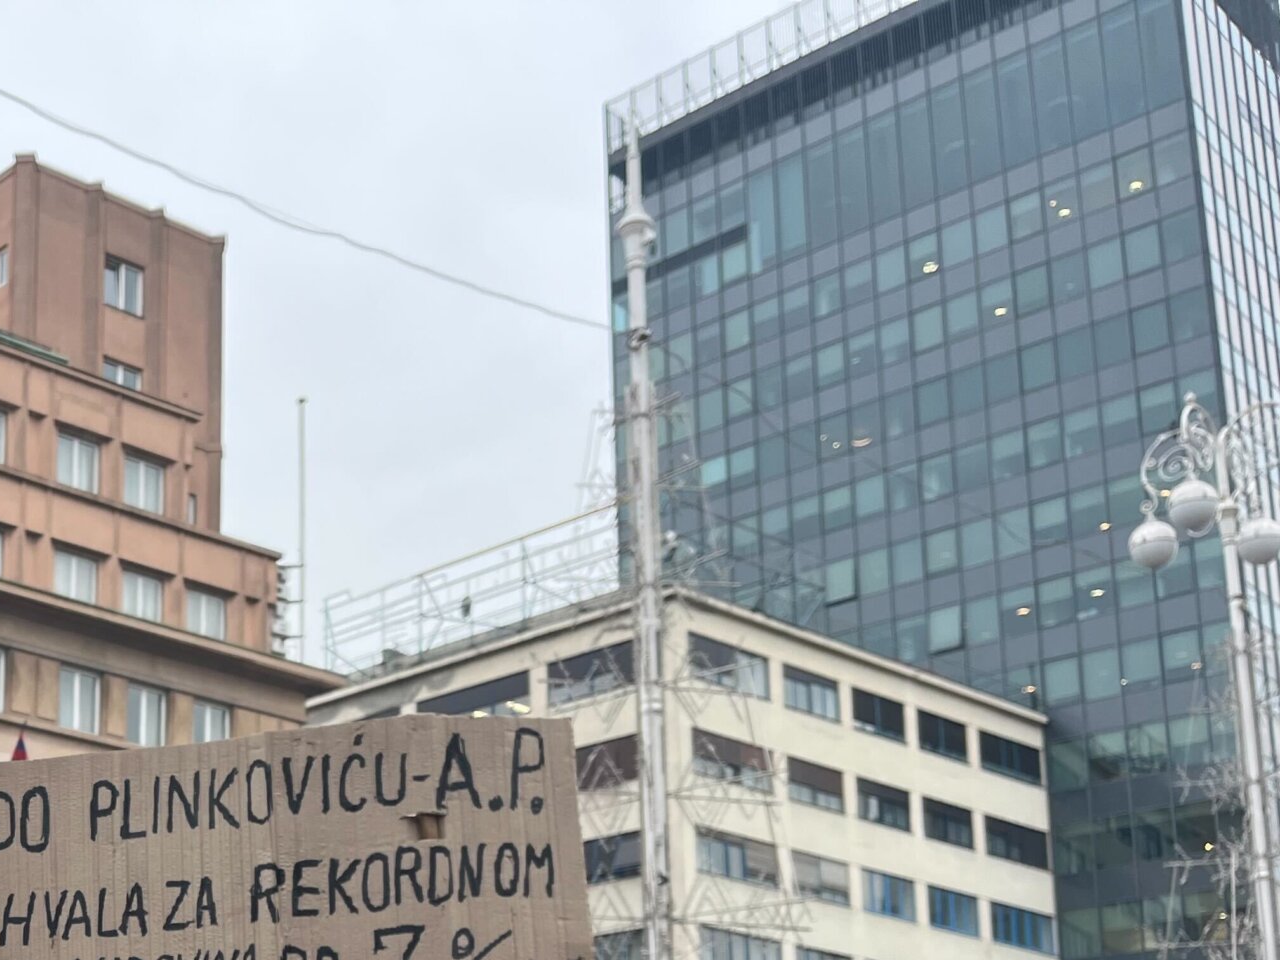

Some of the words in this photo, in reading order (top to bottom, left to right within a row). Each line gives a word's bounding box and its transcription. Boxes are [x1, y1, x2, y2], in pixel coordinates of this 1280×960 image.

[0, 882, 149, 947] HVALA
[163, 876, 219, 932] ZA
[250, 842, 556, 926] REKORDNOM
